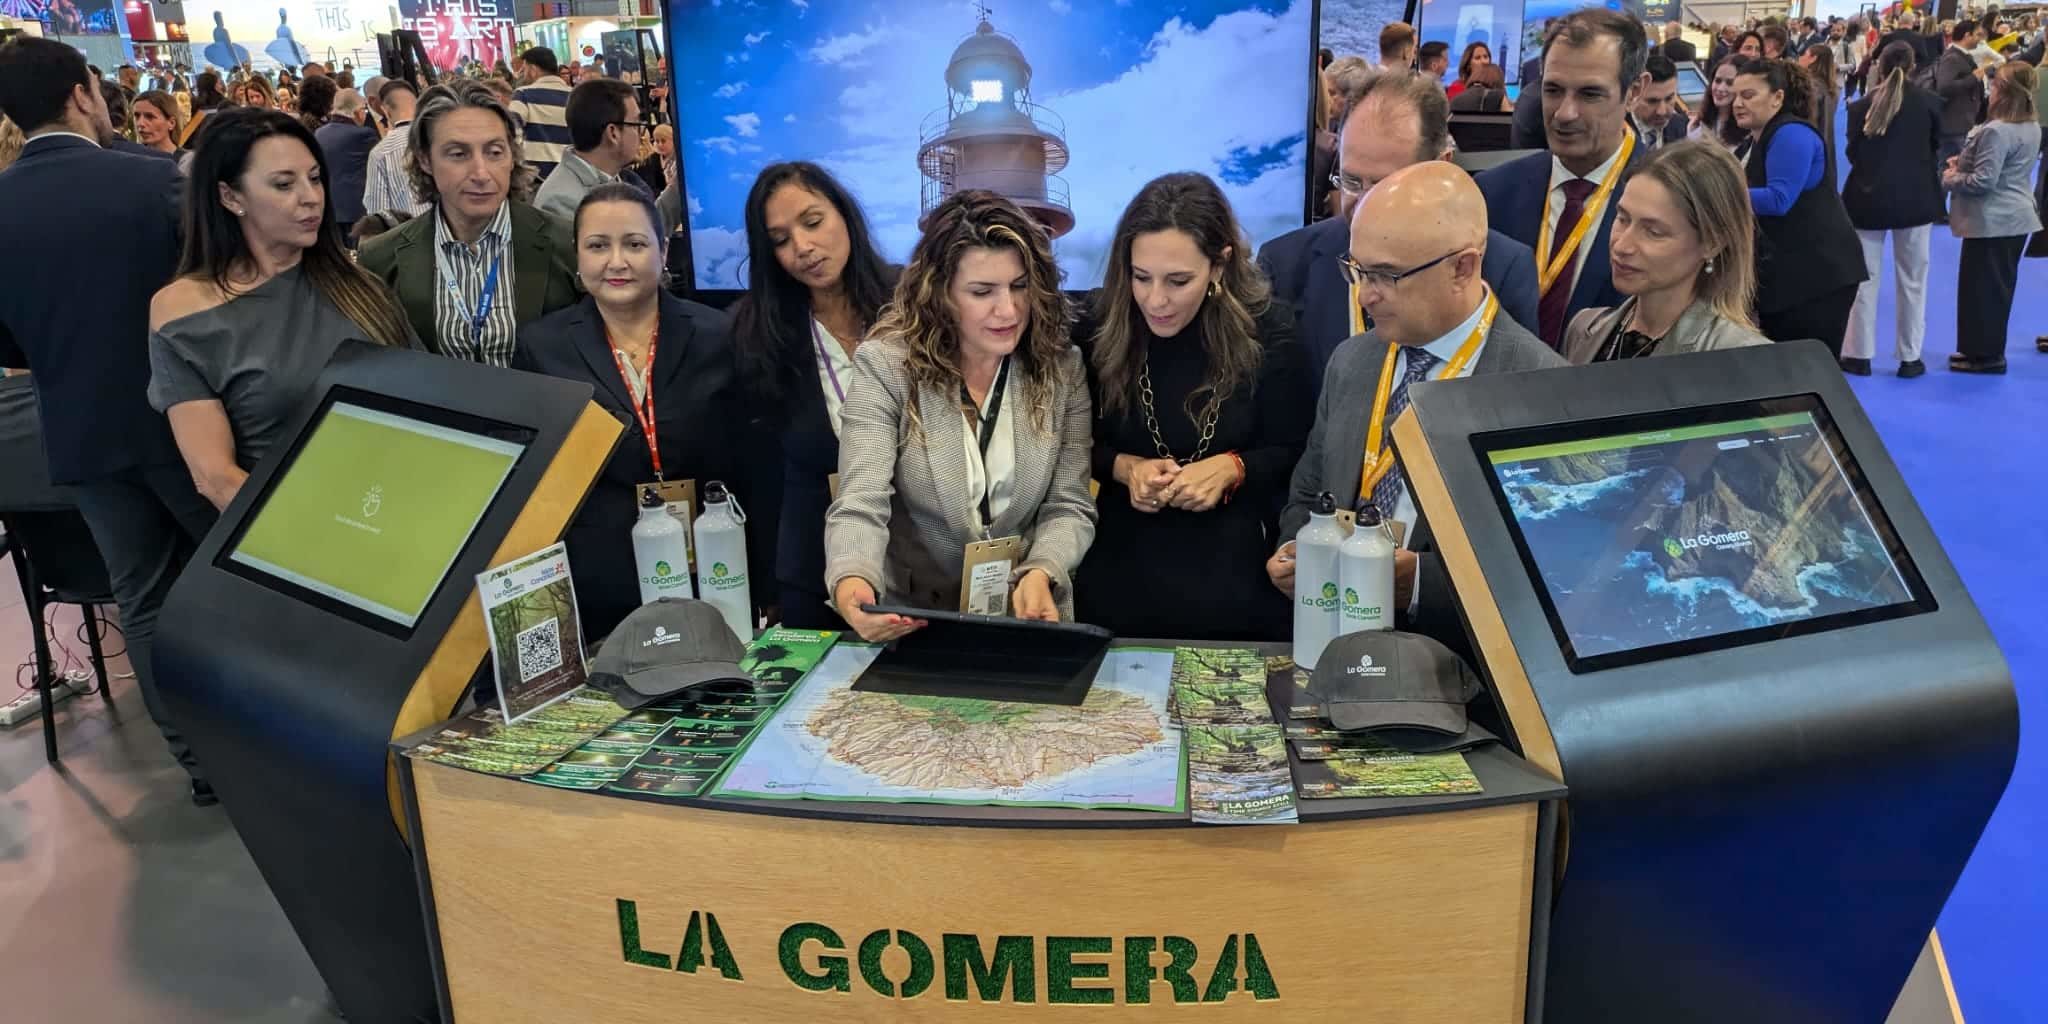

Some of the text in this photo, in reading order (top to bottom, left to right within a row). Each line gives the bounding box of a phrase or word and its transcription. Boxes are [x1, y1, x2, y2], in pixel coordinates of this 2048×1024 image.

[425, 0, 498, 16] THIS
[316, 7, 350, 31] THIS
[361, 20, 377, 42] IS
[449, 18, 514, 40] ART
[1680, 530, 1750, 549] La Gomera
[1302, 595, 1313, 606] La
[1347, 665, 1387, 674] La Gomera
[1244, 794, 1290, 809] GOMERA
[616, 898, 1281, 1006] LA GOMERA
